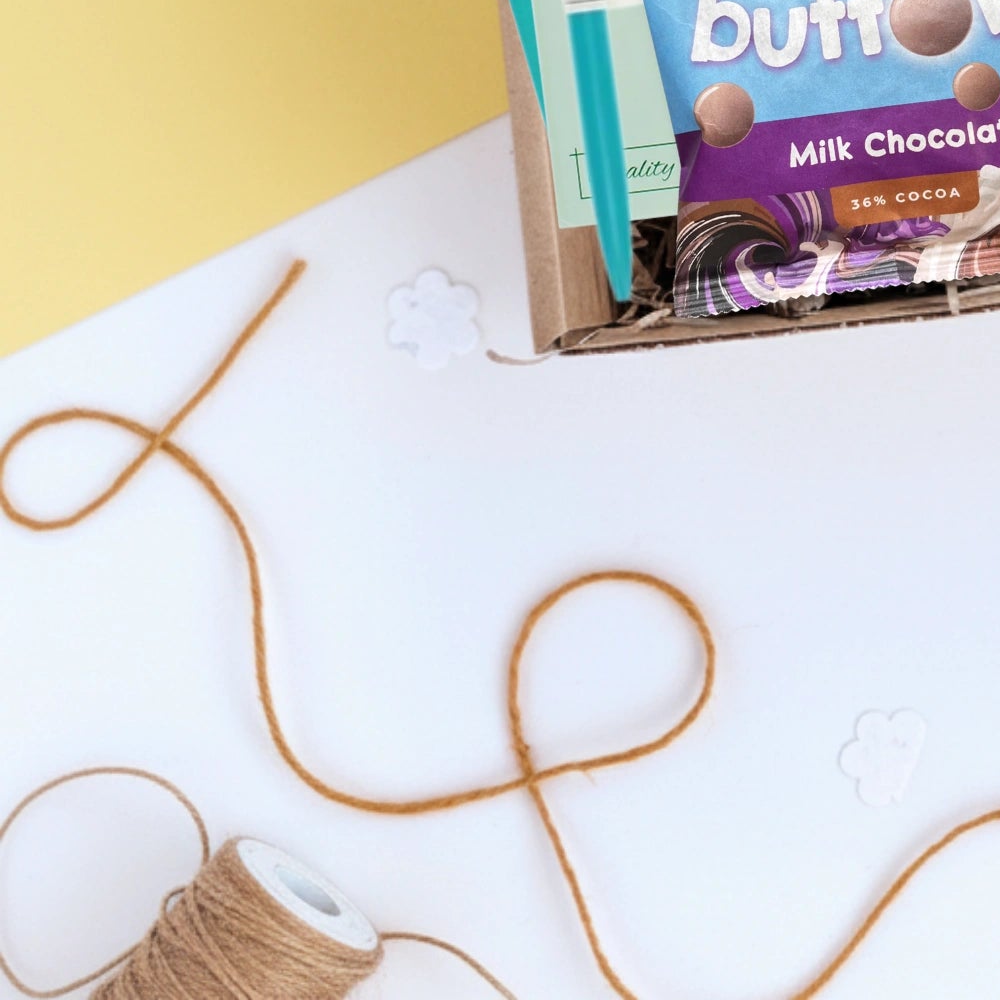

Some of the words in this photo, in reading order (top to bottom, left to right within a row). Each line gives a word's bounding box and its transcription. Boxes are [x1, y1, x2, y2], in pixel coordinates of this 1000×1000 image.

[789, 135, 853, 168] Milk
[627, 159, 675, 182] ality
[851, 194, 887, 210] 36%
[895, 187, 961, 203] COCOA
